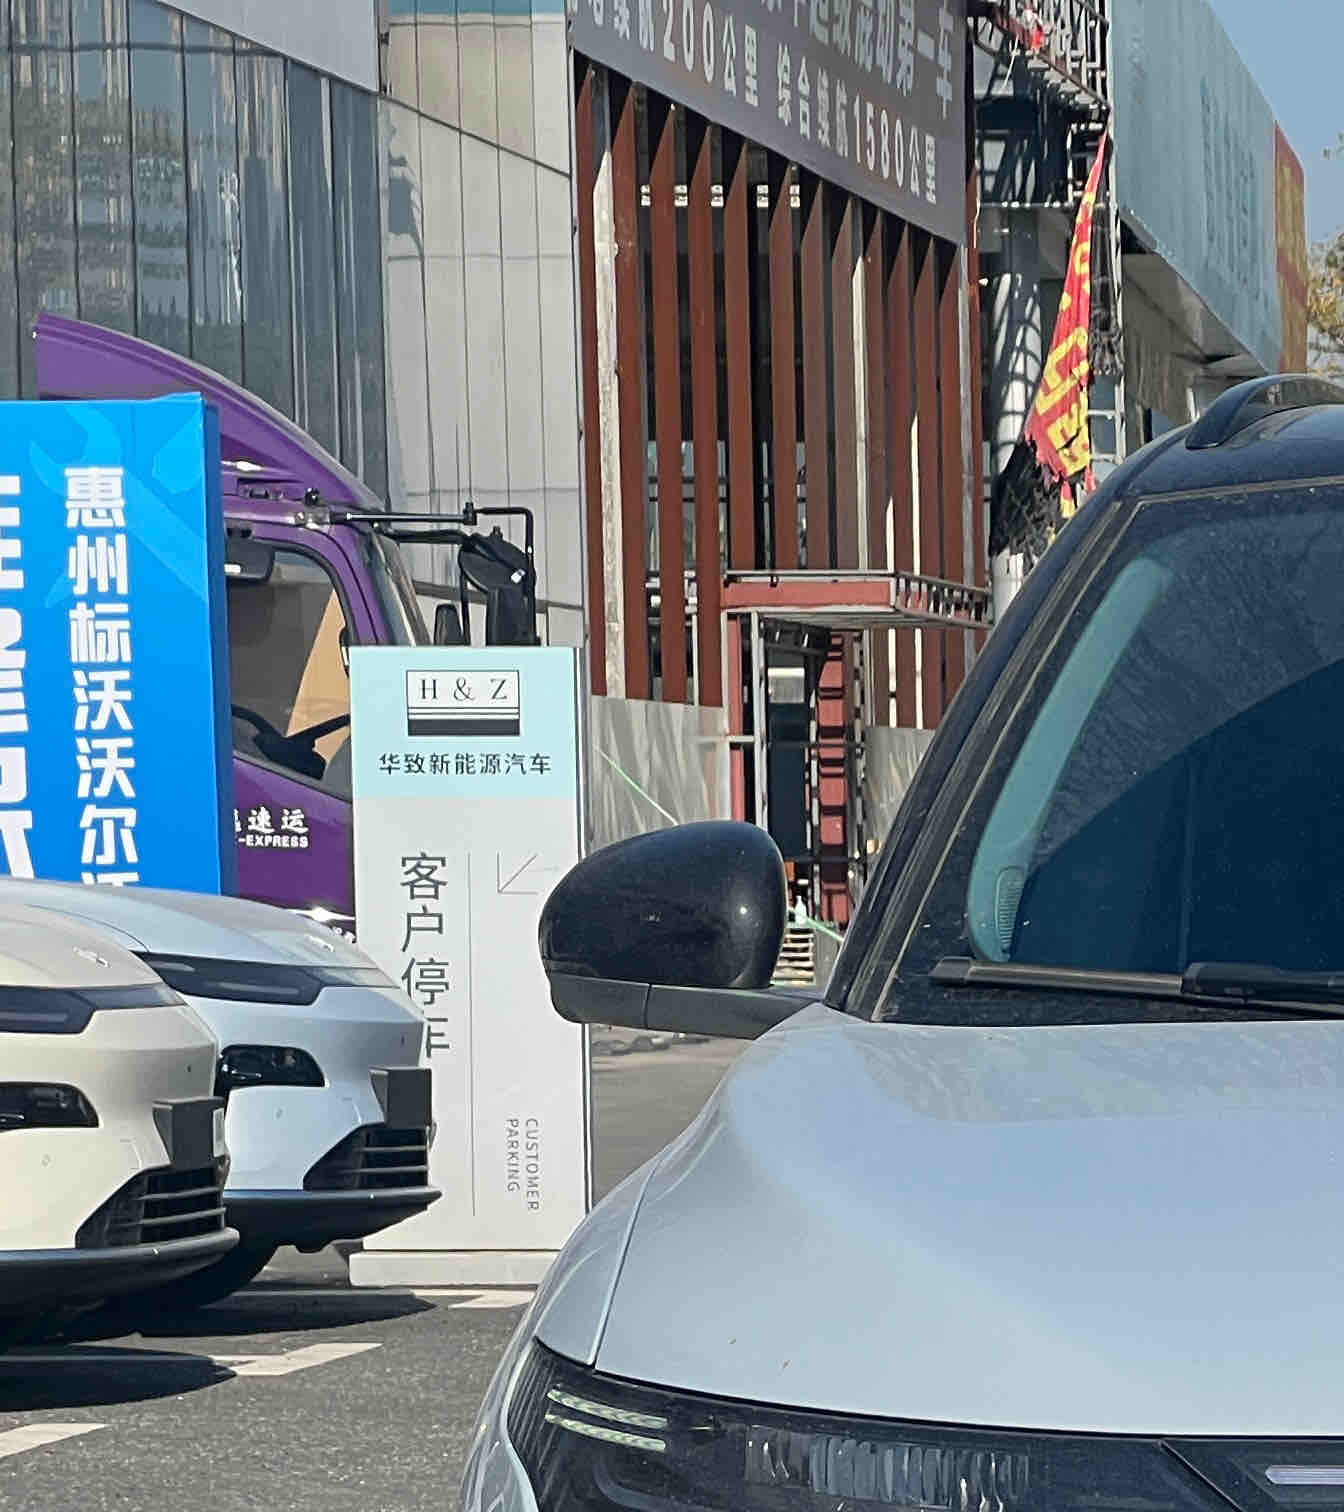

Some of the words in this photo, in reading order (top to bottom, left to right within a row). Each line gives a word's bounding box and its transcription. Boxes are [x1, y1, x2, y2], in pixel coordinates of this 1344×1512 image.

[65, 466, 140, 888] 惠州标沃沃尔
[419, 678, 438, 700] H
[453, 677, 475, 701] &
[490, 678, 508, 700] Z
[379, 753, 552, 775] 华致新能源汽车
[507, 1118, 521, 1193] PARKING
[526, 1118, 540, 1211] CUSTOMER
